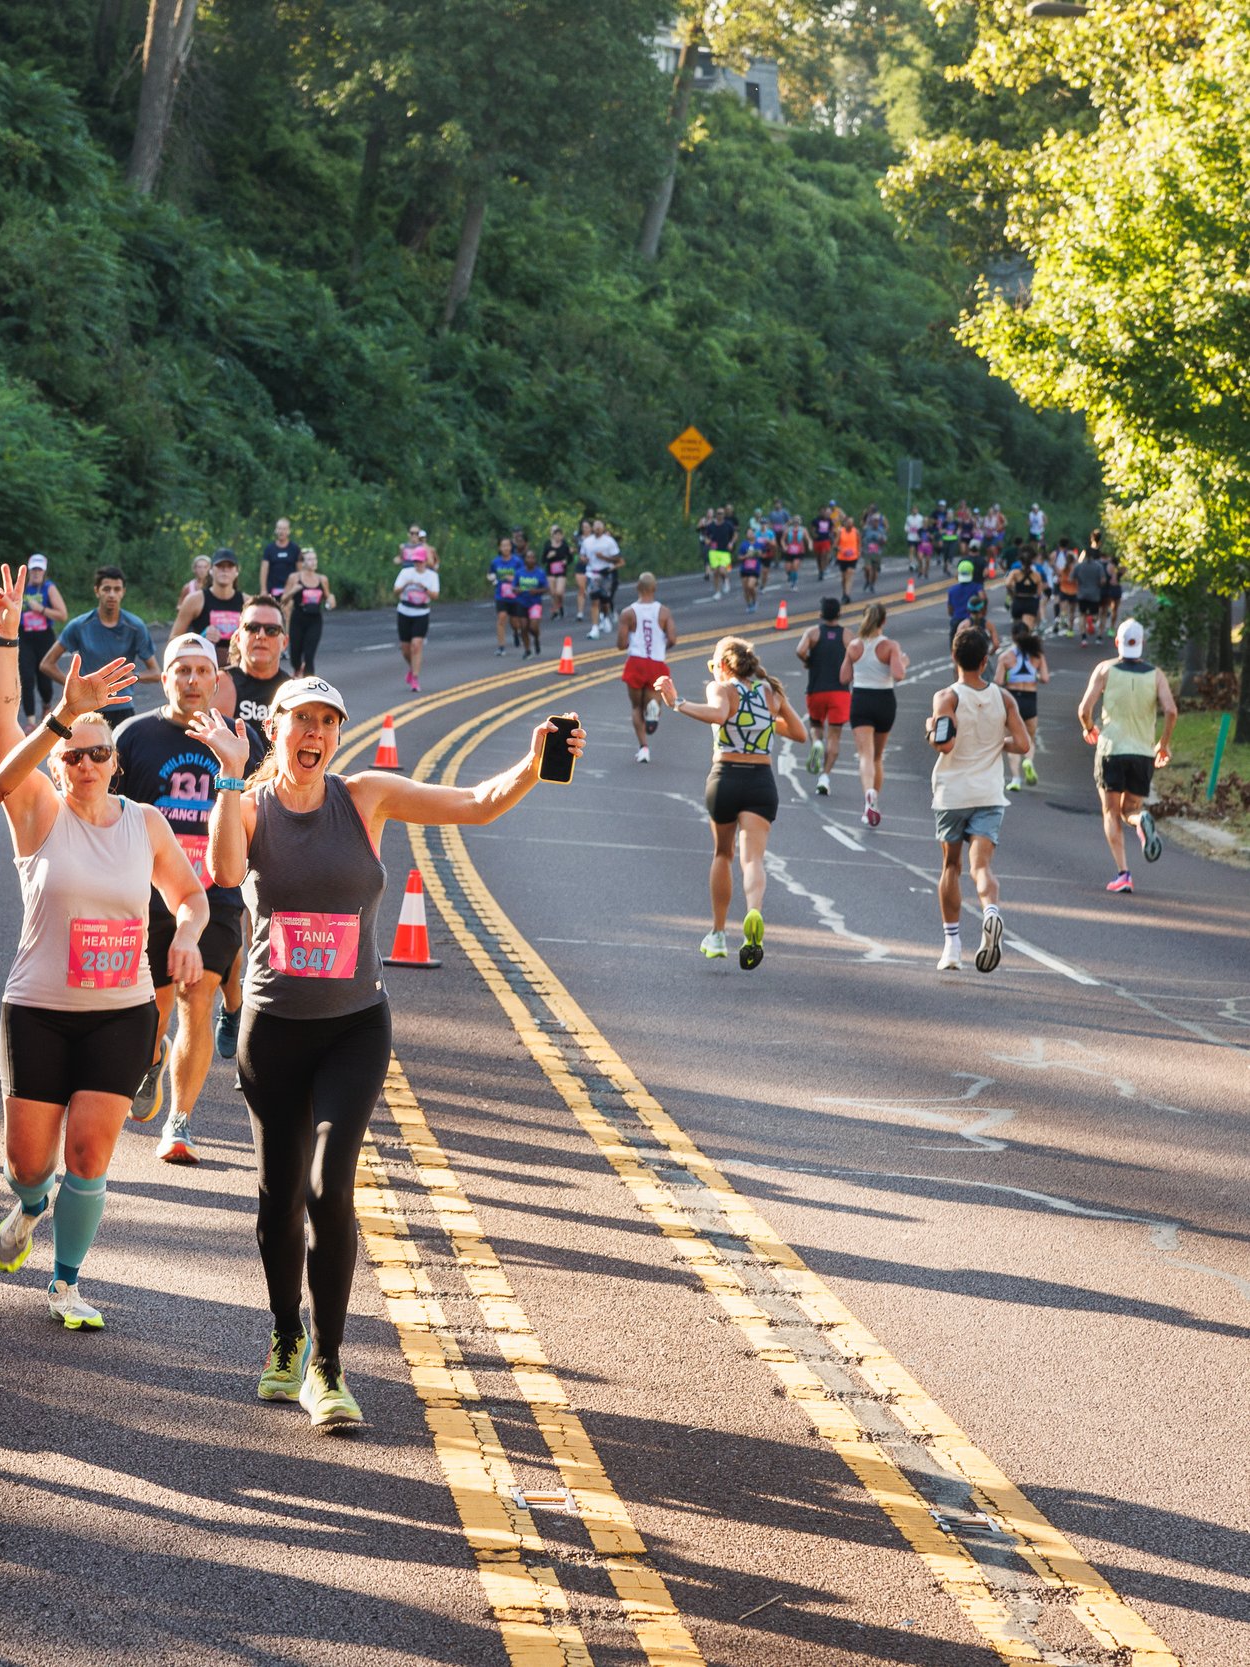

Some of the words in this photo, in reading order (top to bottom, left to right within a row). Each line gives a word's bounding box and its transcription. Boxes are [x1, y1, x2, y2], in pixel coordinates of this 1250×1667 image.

[170, 772, 210, 801] 13.1
[81, 935, 137, 947] HEATHER
[294, 930, 335, 944] TANIA
[81, 949, 135, 972] 2807
[290, 947, 337, 972] 847
